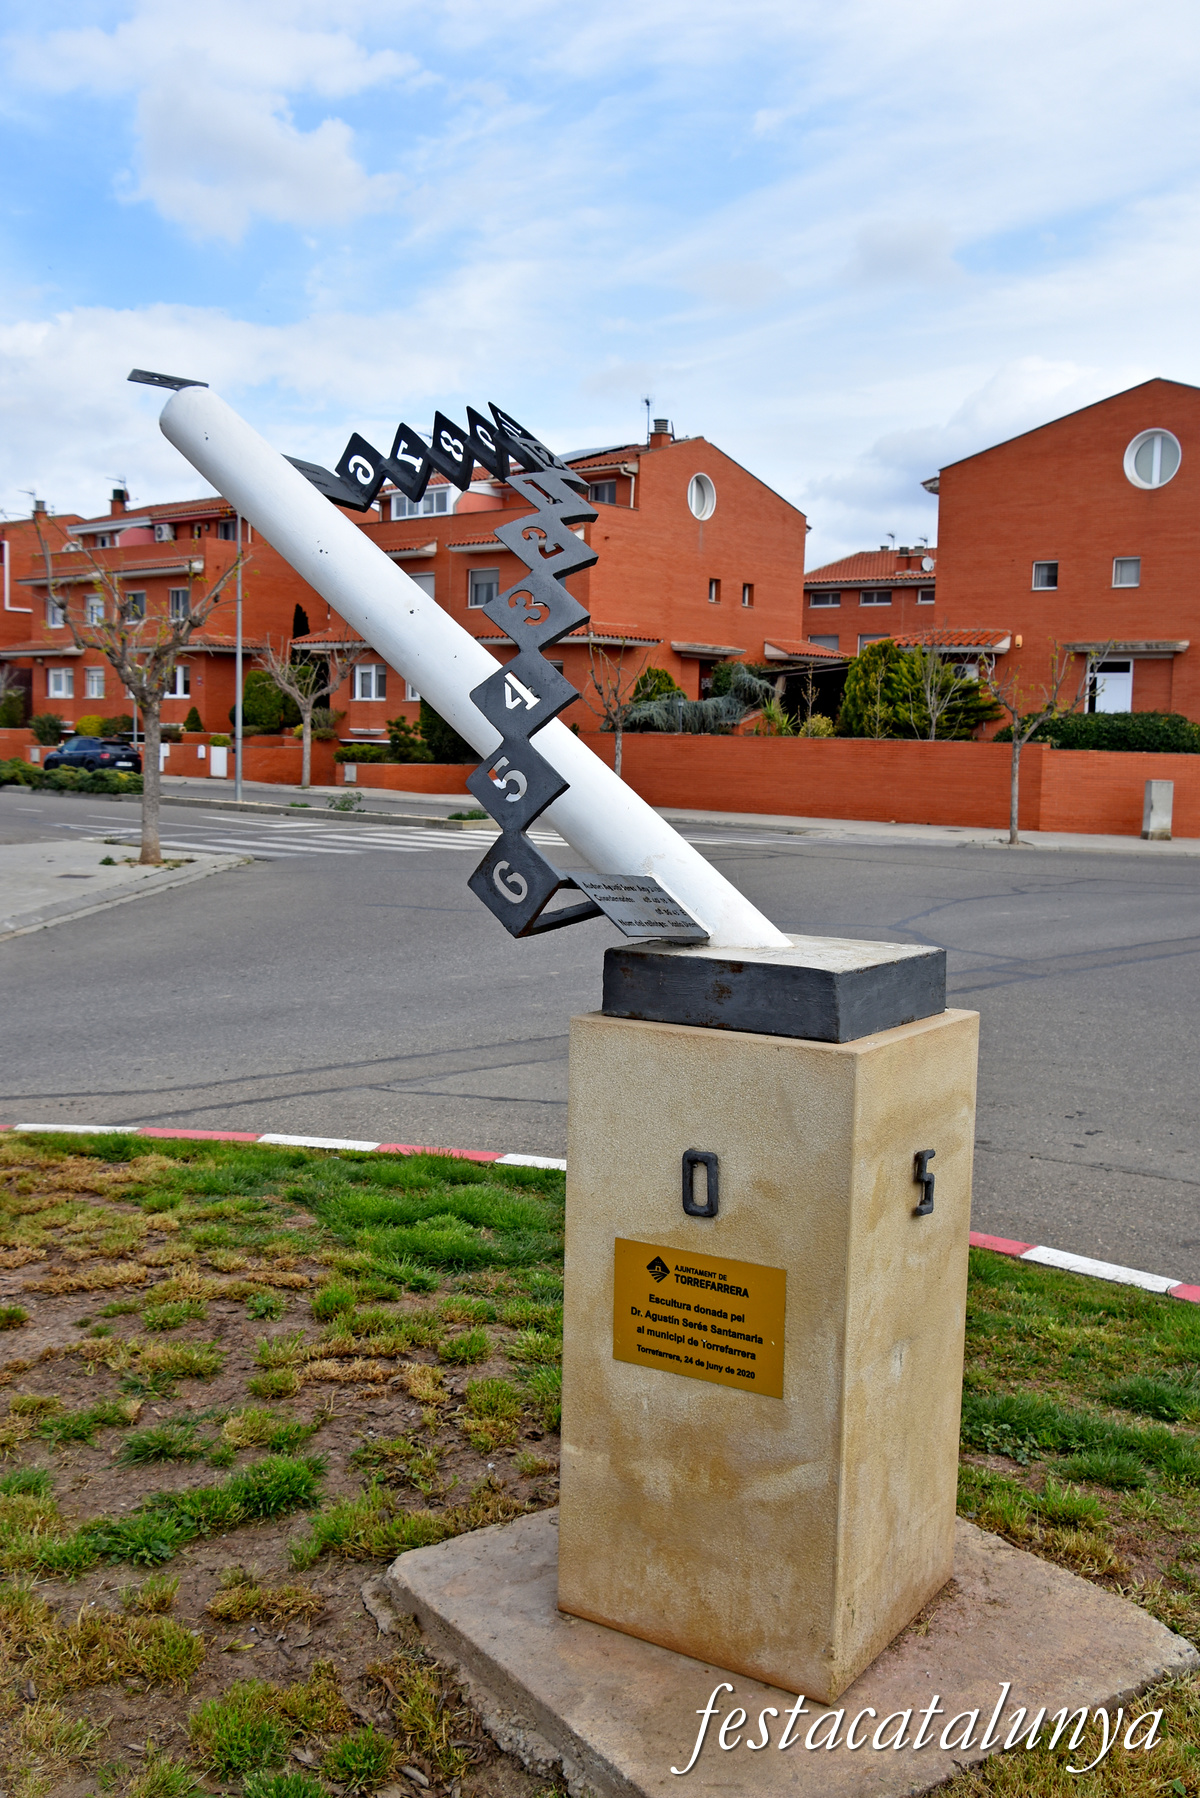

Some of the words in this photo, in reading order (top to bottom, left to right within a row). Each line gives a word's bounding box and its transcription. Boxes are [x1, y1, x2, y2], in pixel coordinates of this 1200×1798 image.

[520, 442, 569, 471] 12
[522, 479, 563, 504] 1
[521, 526, 565, 559] 2
[508, 589, 551, 626] 3
[504, 670, 541, 710] 4
[487, 756, 528, 802] 5
[492, 860, 528, 904] 6
[674, 1265, 717, 1279] AJUNTAMENT
[718, 1273, 728, 1281] DE
[674, 1274, 749, 1298] TORREFARRERA
[630, 1306, 643, 1317] Dr.
[645, 1310, 680, 1325] Agustín
[682, 1318, 708, 1332] Serés
[710, 1325, 763, 1345] Santamaria
[649, 1294, 692, 1311] Escultura
[694, 1304, 728, 1320] donada
[730, 1312, 745, 1323] pel
[636, 1325, 645, 1334] al
[647, 1329, 685, 1344] municipi
[687, 1336, 699, 1347] de
[701, 1339, 756, 1360] Torrefarrera
[636, 1344, 682, 1363] Torrefarrera,
[684, 1355, 693, 1365] 24
[695, 1358, 705, 1367] de
[706, 1360, 723, 1373] juny
[725, 1365, 735, 1374] de
[737, 1368, 755, 1380] 2020
